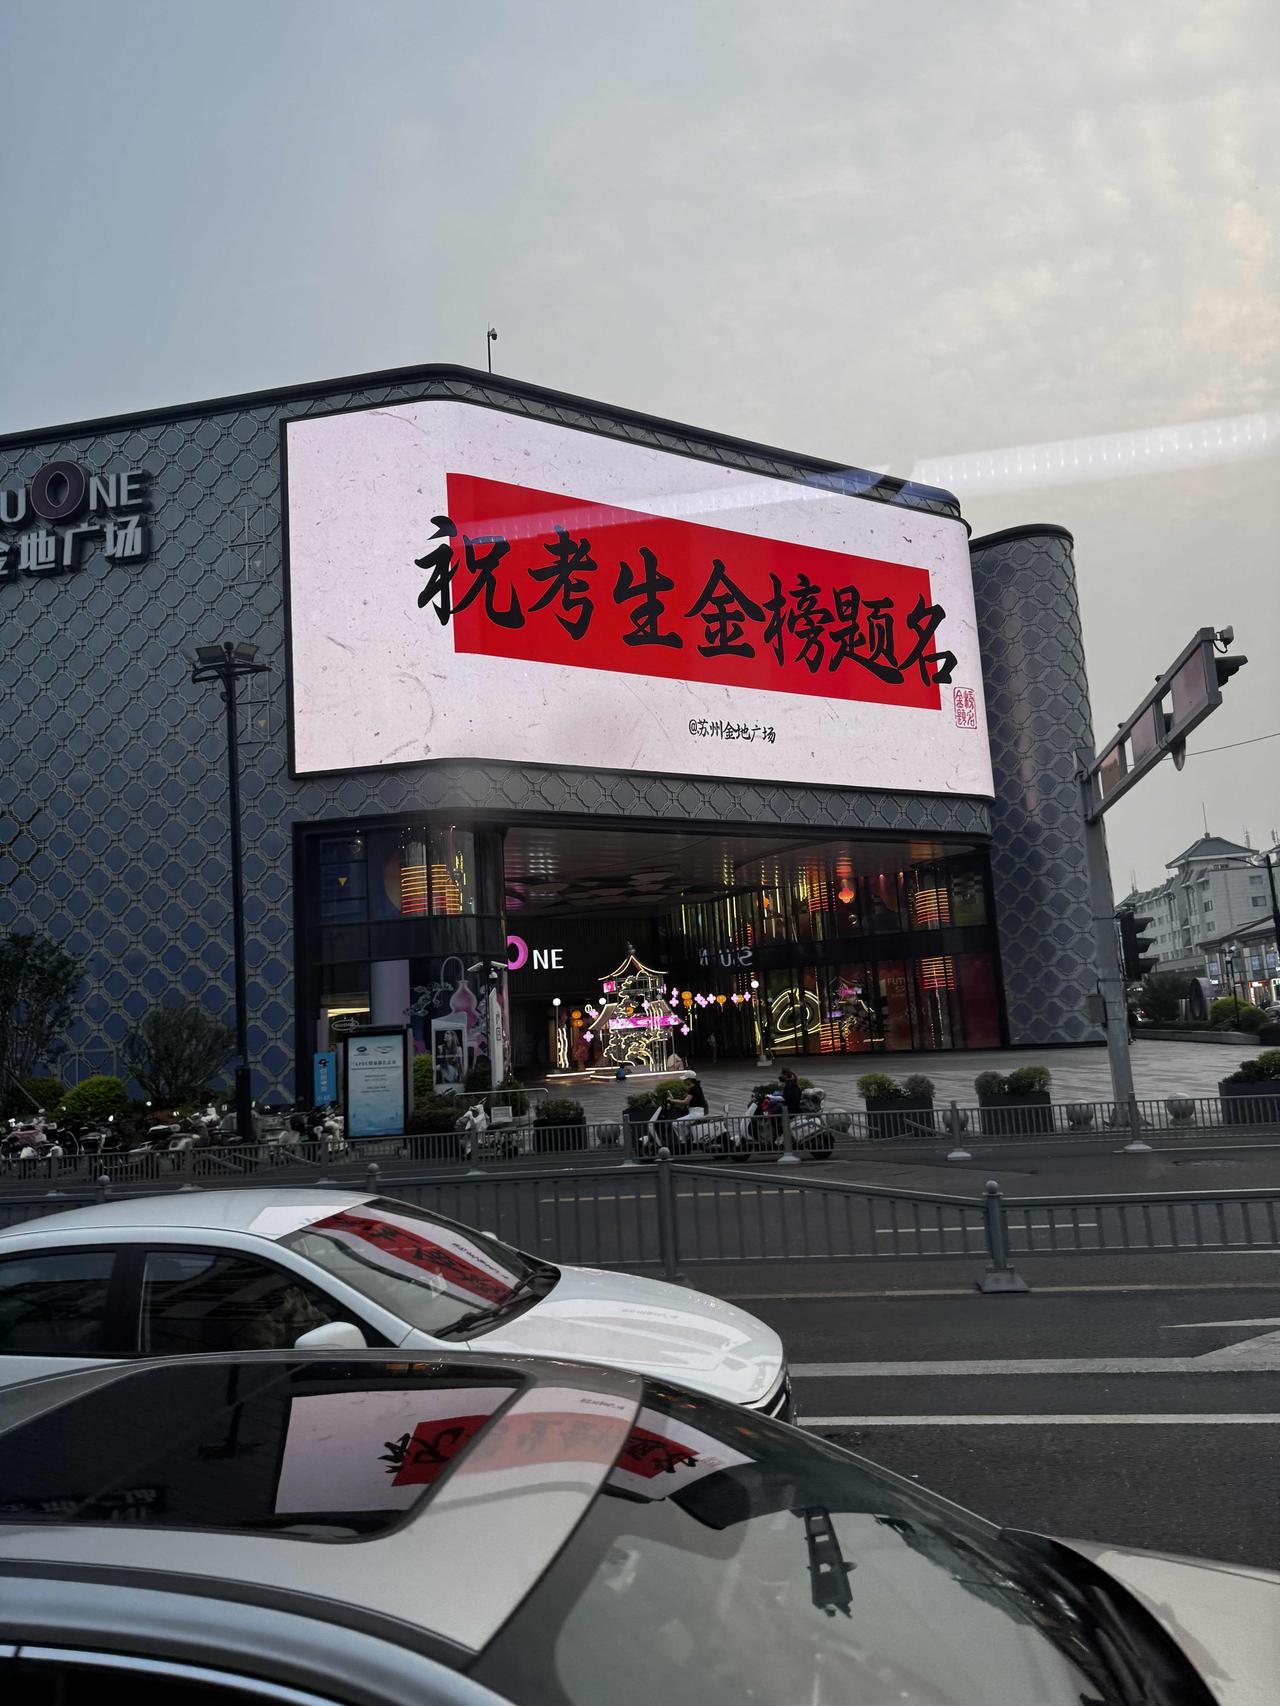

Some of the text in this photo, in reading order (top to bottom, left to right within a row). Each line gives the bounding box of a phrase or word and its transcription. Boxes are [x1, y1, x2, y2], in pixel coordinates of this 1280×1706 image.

[0, 515, 142, 575] 地广场
[415, 516, 958, 687] 祝考生金榜题名
[688, 719, 776, 744] @苏州金地广场
[507, 935, 564, 970] ONE
